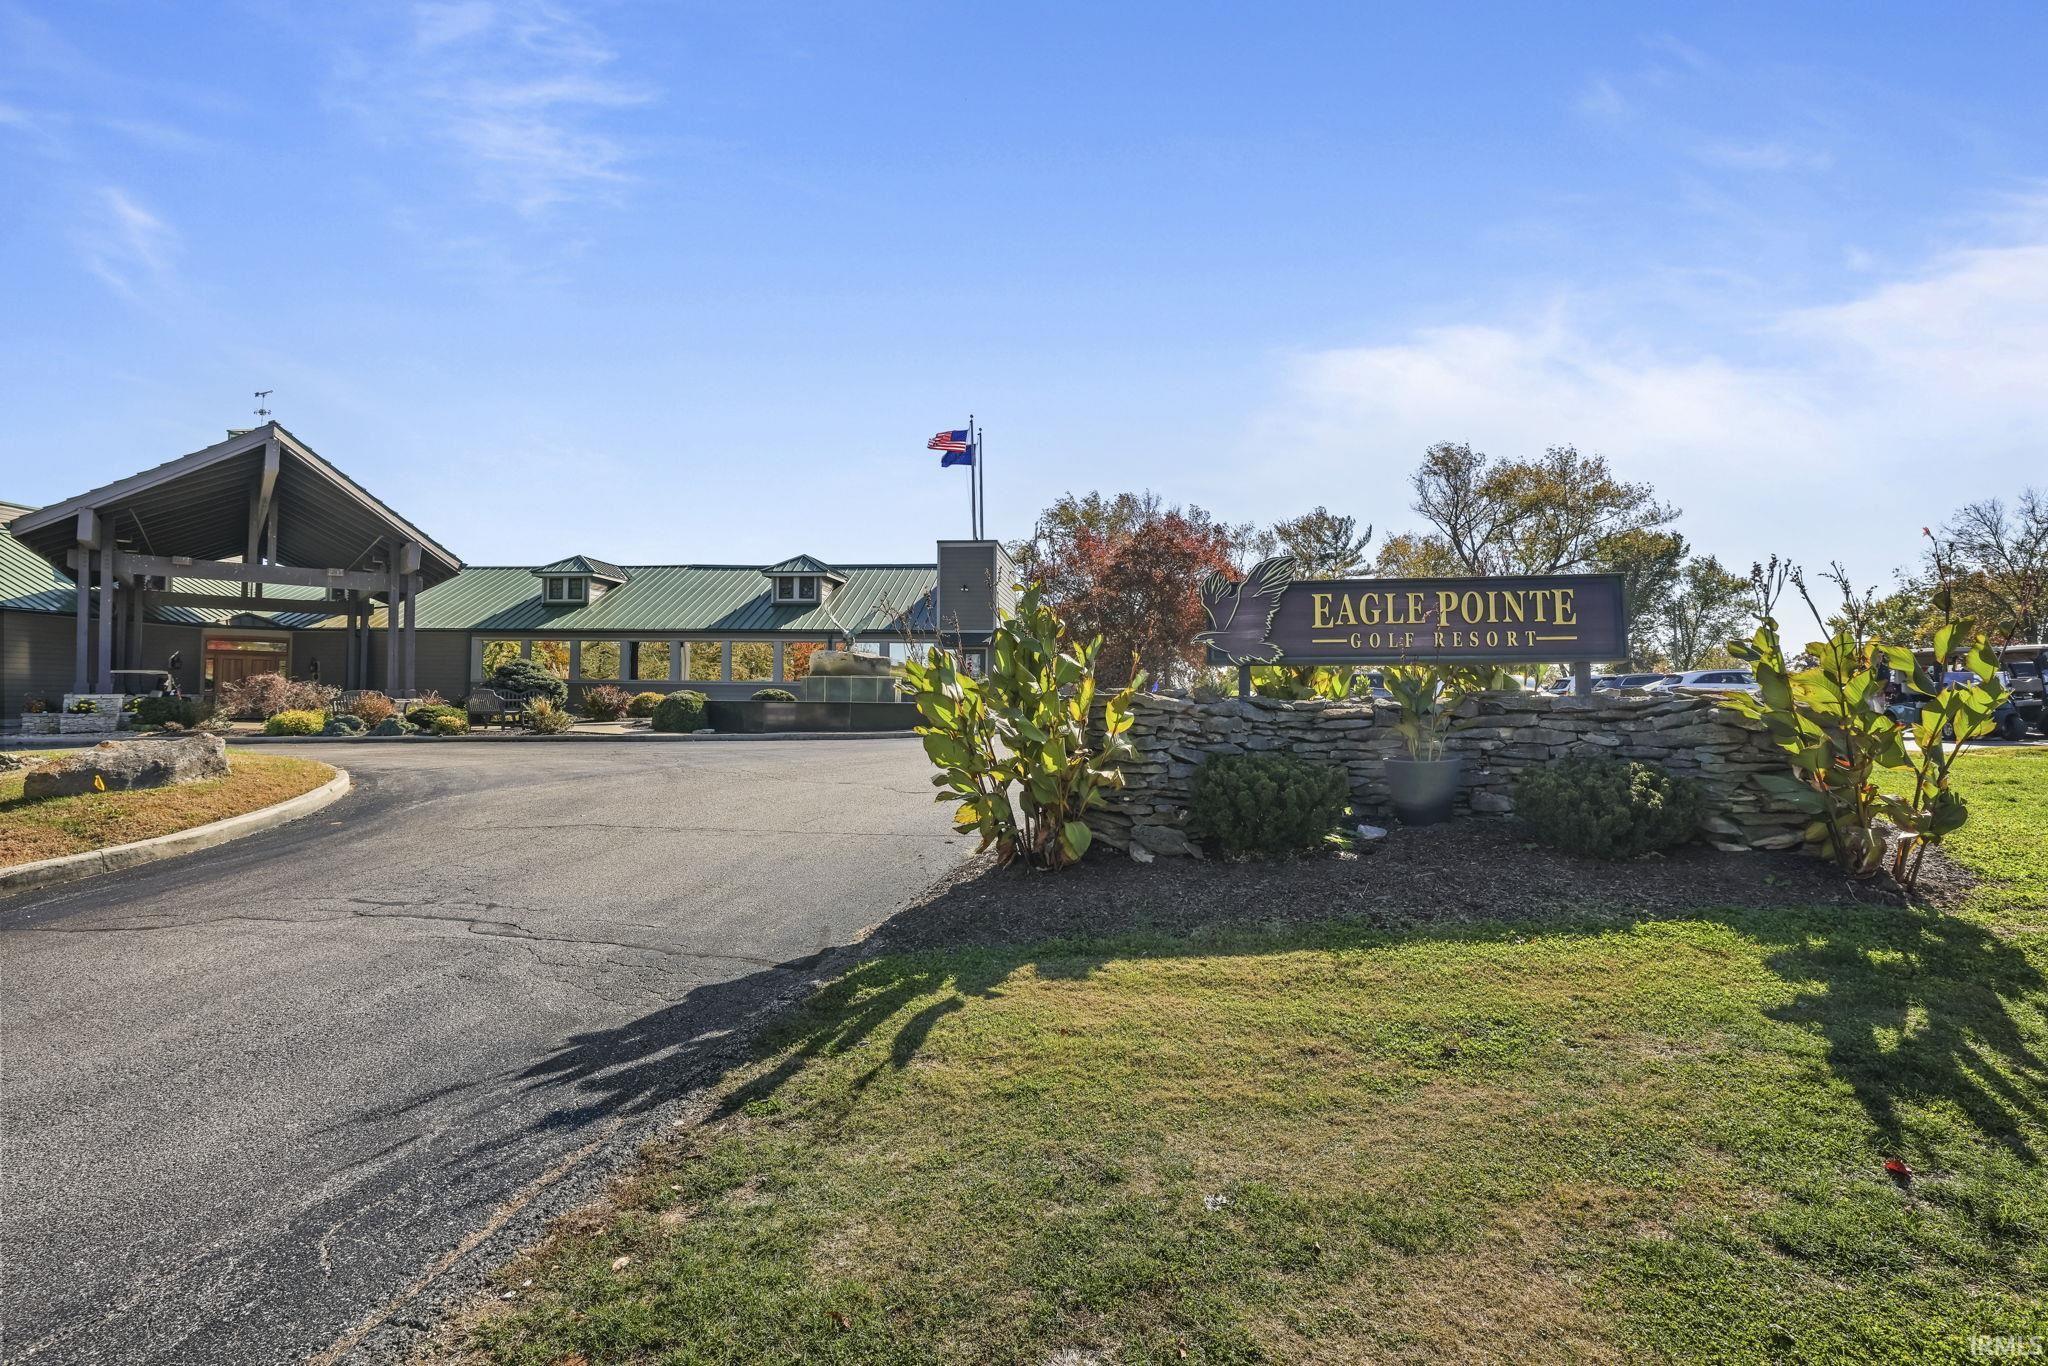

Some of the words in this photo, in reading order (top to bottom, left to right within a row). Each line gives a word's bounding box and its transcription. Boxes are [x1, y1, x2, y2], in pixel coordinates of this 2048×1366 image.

[1312, 592, 1426, 629] EAGLE
[1436, 588, 1577, 627] POINTE
[1350, 632, 1414, 649] GOLF
[1434, 630, 1537, 648] RESORT
